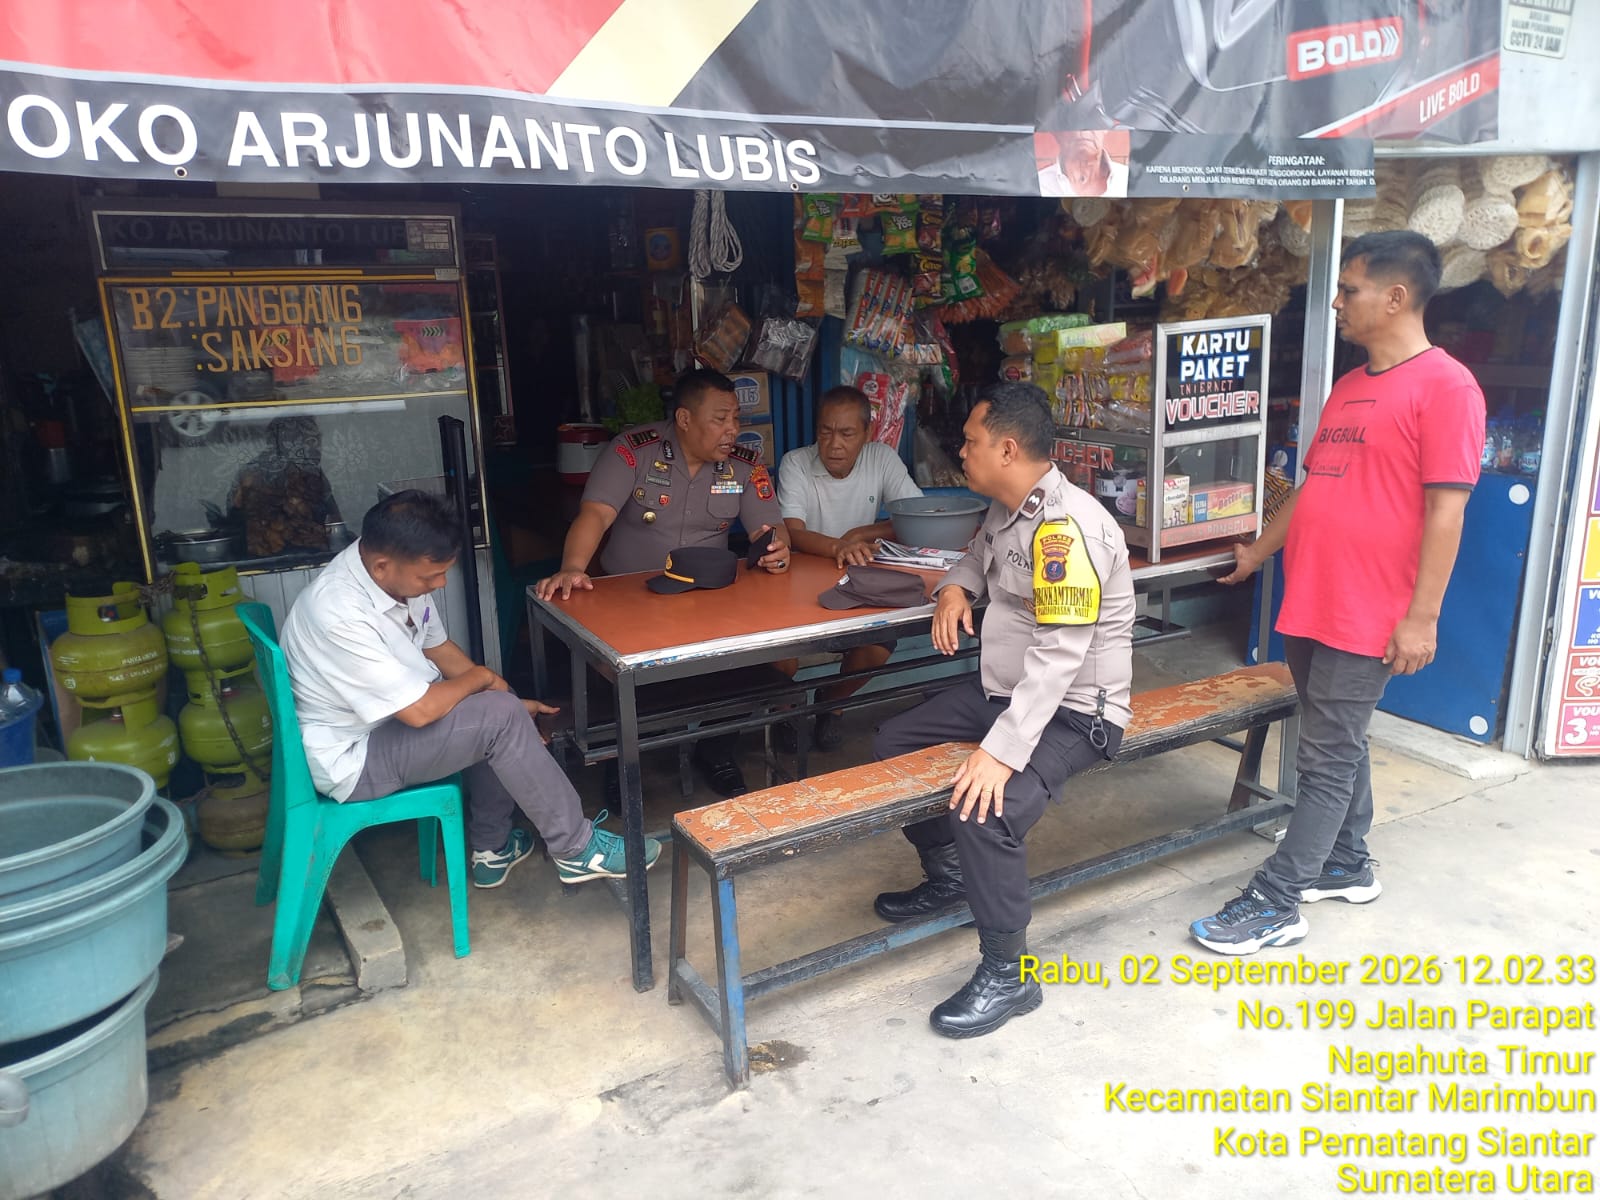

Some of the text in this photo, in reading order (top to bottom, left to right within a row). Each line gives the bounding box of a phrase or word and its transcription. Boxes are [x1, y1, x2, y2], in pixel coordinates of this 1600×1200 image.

[1297, 29, 1383, 73] BOLD
[1418, 72, 1480, 124] LIVE BOLD
[227, 110, 648, 177] ARJUNANTO
[664, 131, 821, 185] LUBIS
[1268, 155, 1326, 167] PERINGATAN:
[1159, 175, 1191, 184] DILARANG
[1317, 169, 1349, 177] LAYANAN
[1181, 329, 1251, 357] KARTU
[1180, 354, 1250, 383] PAKET
[1165, 389, 1260, 425] VOUCHER
[1318, 426, 1367, 444] BIGBULL
[1042, 534, 1073, 546] POLRES
[1564, 717, 1589, 745] 3
